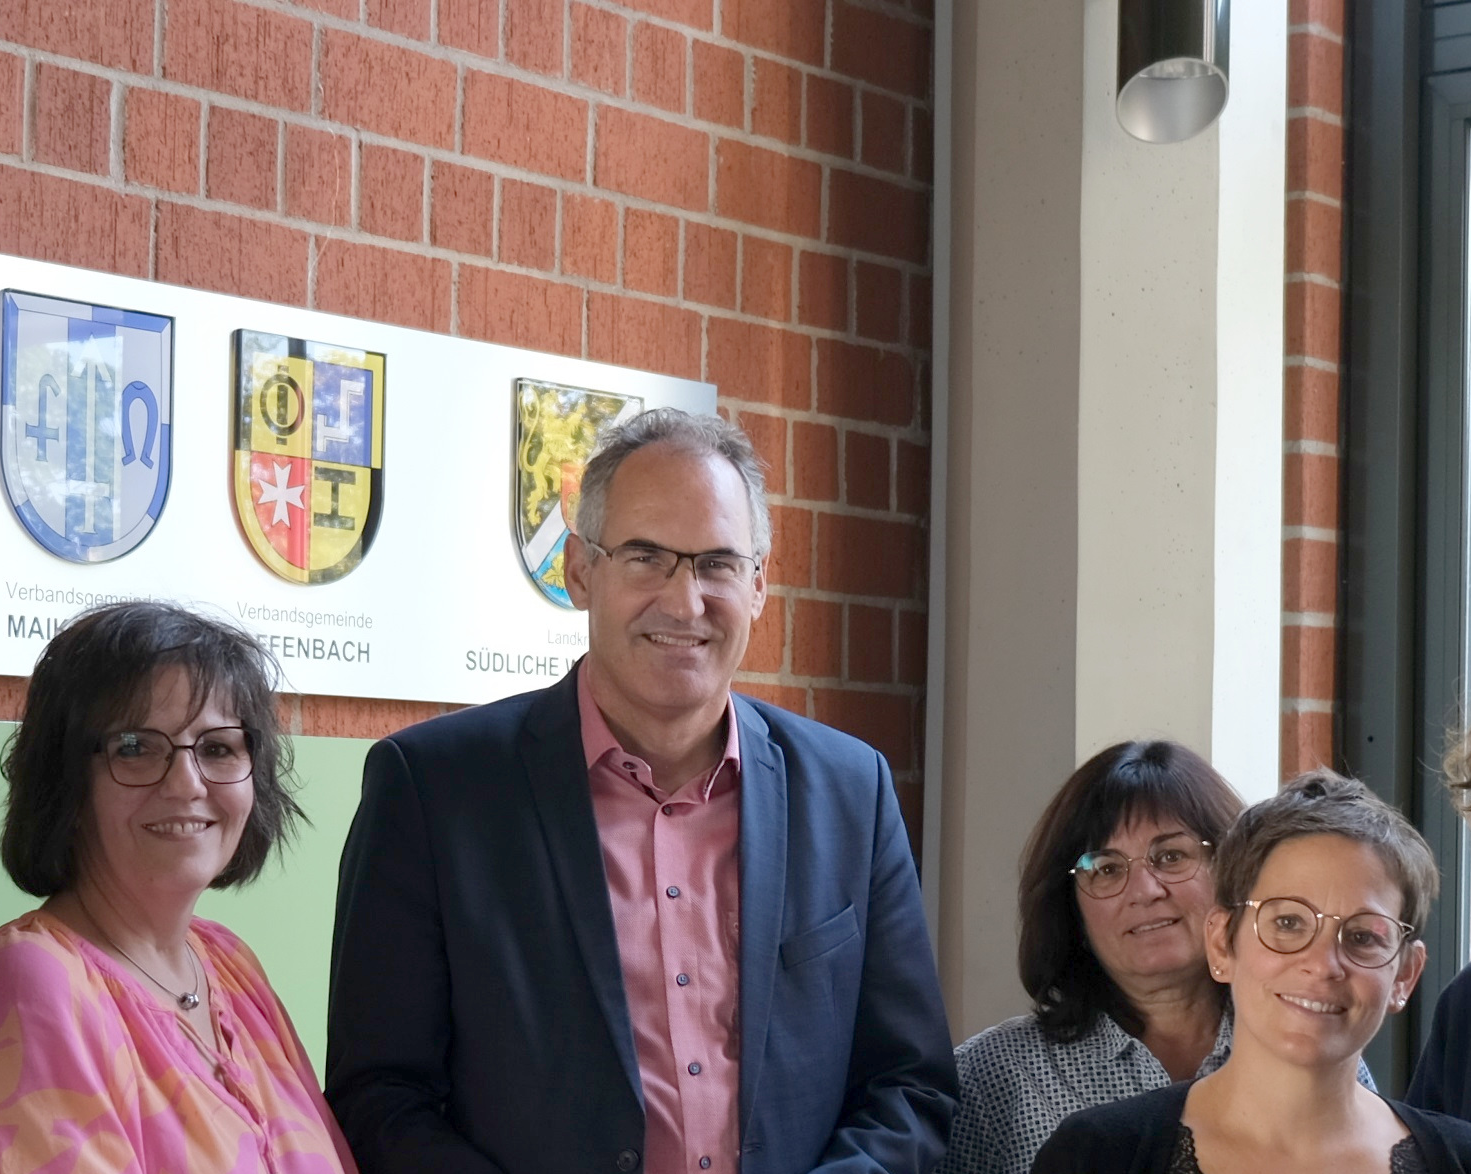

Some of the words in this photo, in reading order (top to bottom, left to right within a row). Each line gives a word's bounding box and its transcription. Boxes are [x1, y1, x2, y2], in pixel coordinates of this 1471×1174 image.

[237, 601, 373, 629] Verbandsgemeinde
[256, 634, 371, 664] FFENBACH
[547, 629, 588, 646] Landkr
[465, 647, 559, 677] SÜDLICHE
